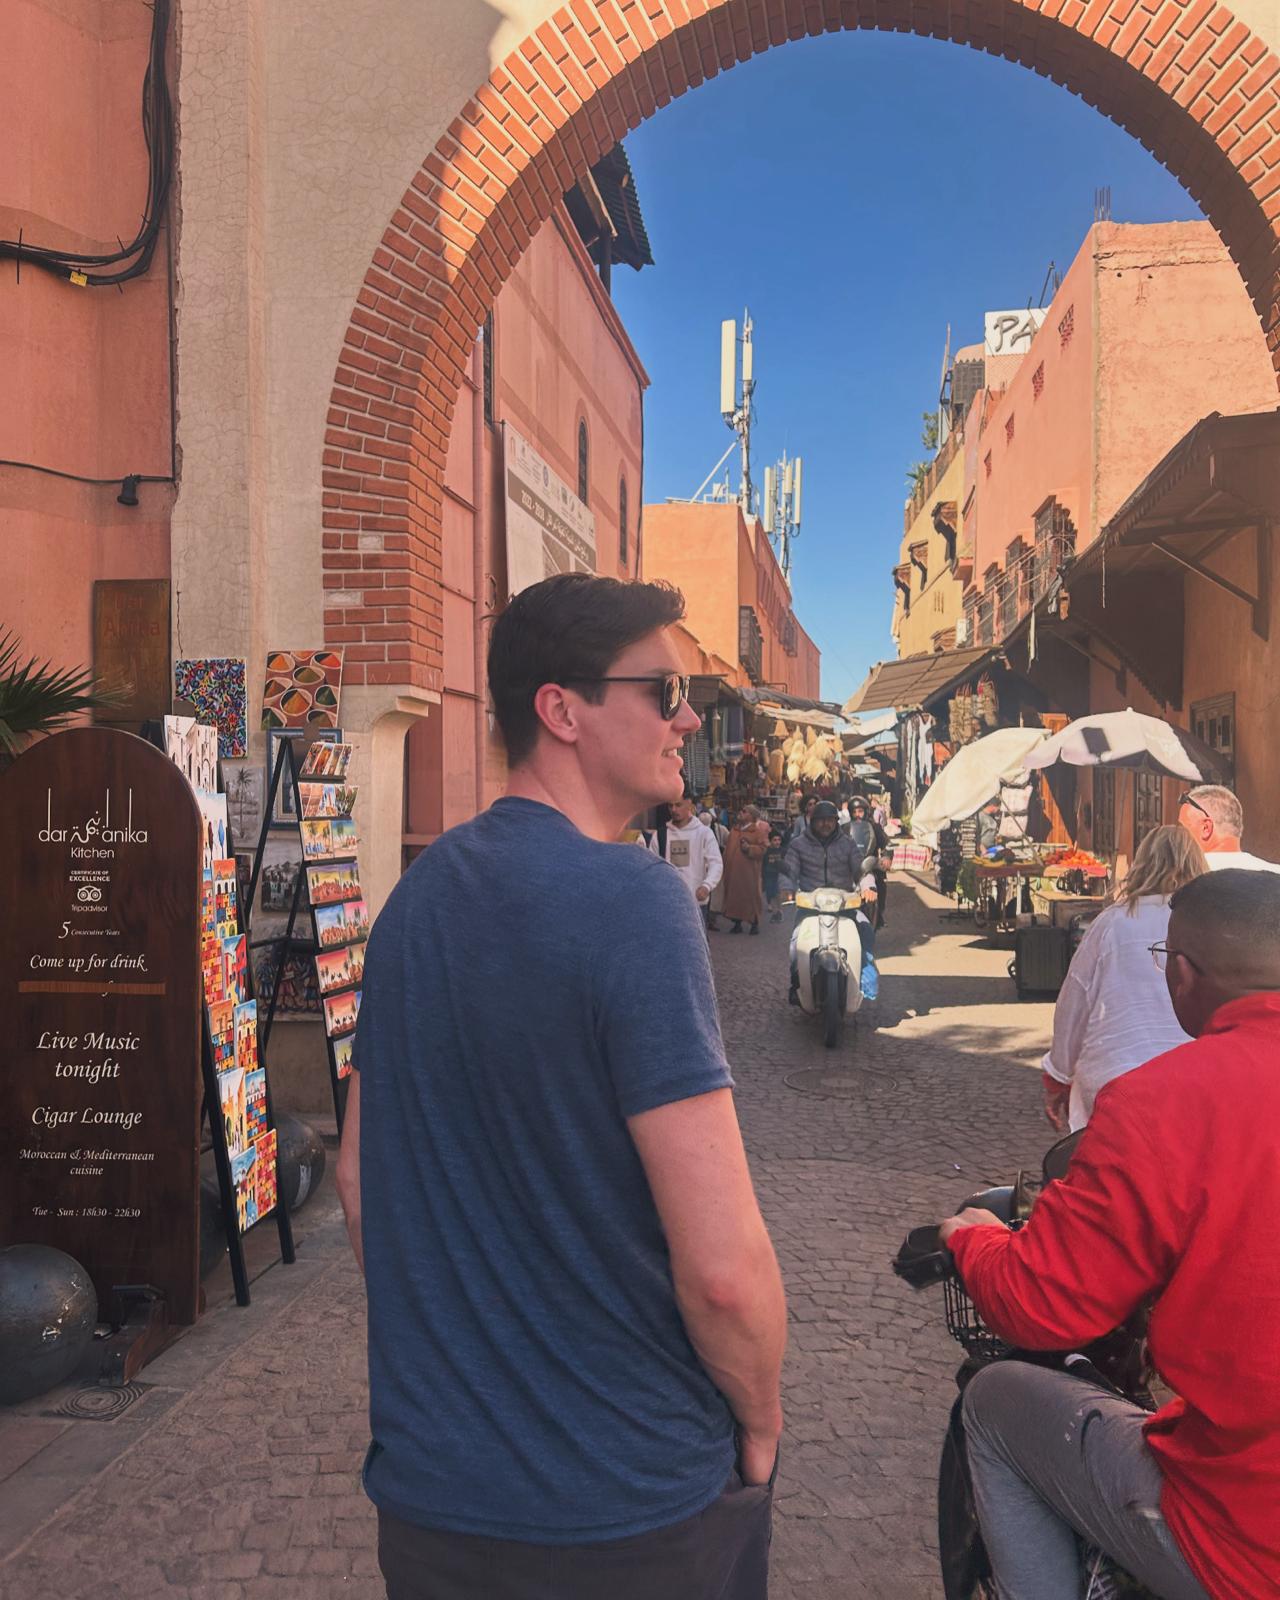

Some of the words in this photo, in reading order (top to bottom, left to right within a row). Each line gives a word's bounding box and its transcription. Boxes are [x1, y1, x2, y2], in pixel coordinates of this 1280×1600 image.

[38, 787, 68, 842] dar
[101, 788, 148, 843] anika
[70, 847, 115, 859] Kitchen
[58, 920, 71, 939] 5
[30, 954, 64, 969] Come
[68, 958, 84, 972] up
[84, 953, 108, 973] for
[110, 953, 148, 972] drink
[36, 1031, 78, 1049] Live
[83, 1031, 140, 1050] Music
[55, 1058, 121, 1084] tonight
[31, 1106, 77, 1129] Cigar
[80, 1107, 143, 1130] Lounge
[19, 1149, 67, 1160] Moroccan
[69, 1149, 82, 1160] &
[83, 1149, 155, 1161] Mediterranean
[69, 1164, 104, 1175] cuisine
[32, 1206, 48, 1216] Tue
[82, 1207, 107, 1217] 18h30
[114, 1208, 141, 1218] 22h30
